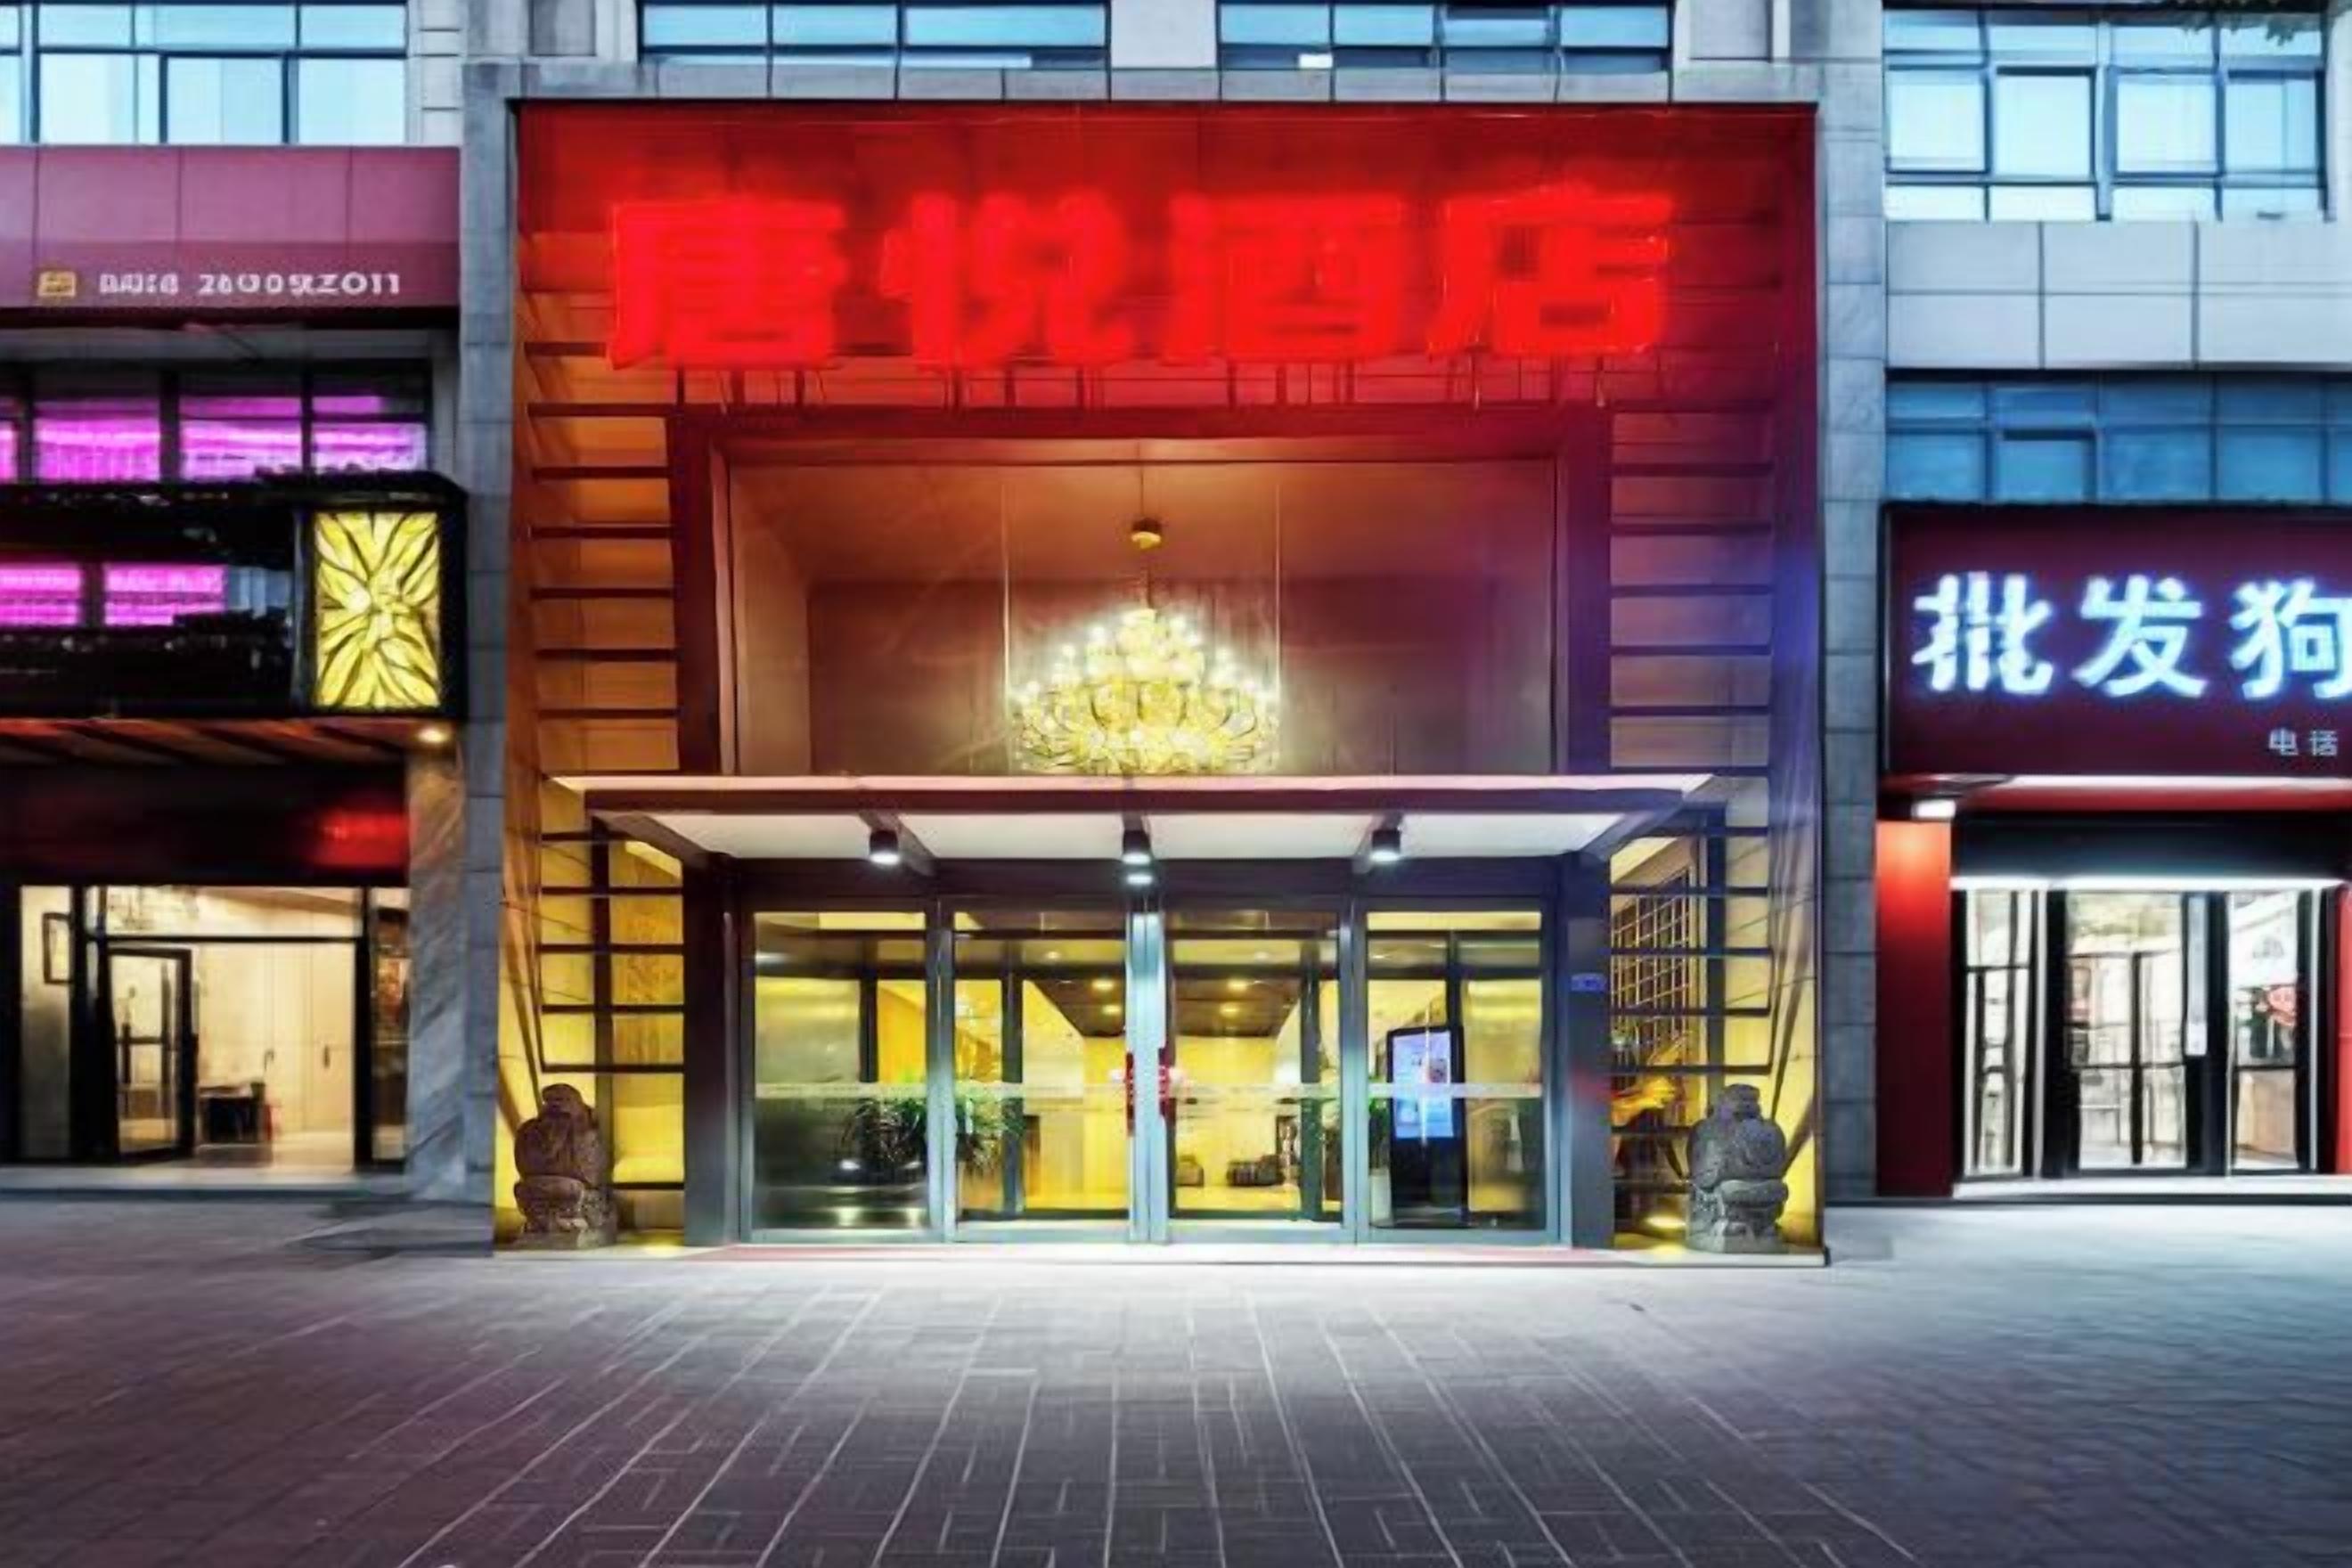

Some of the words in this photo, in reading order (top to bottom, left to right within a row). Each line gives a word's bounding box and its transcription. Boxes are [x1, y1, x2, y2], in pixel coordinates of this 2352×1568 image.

[608, 184, 1671, 368] 唐悦酒店
[2268, 728, 2339, 756] 电话
